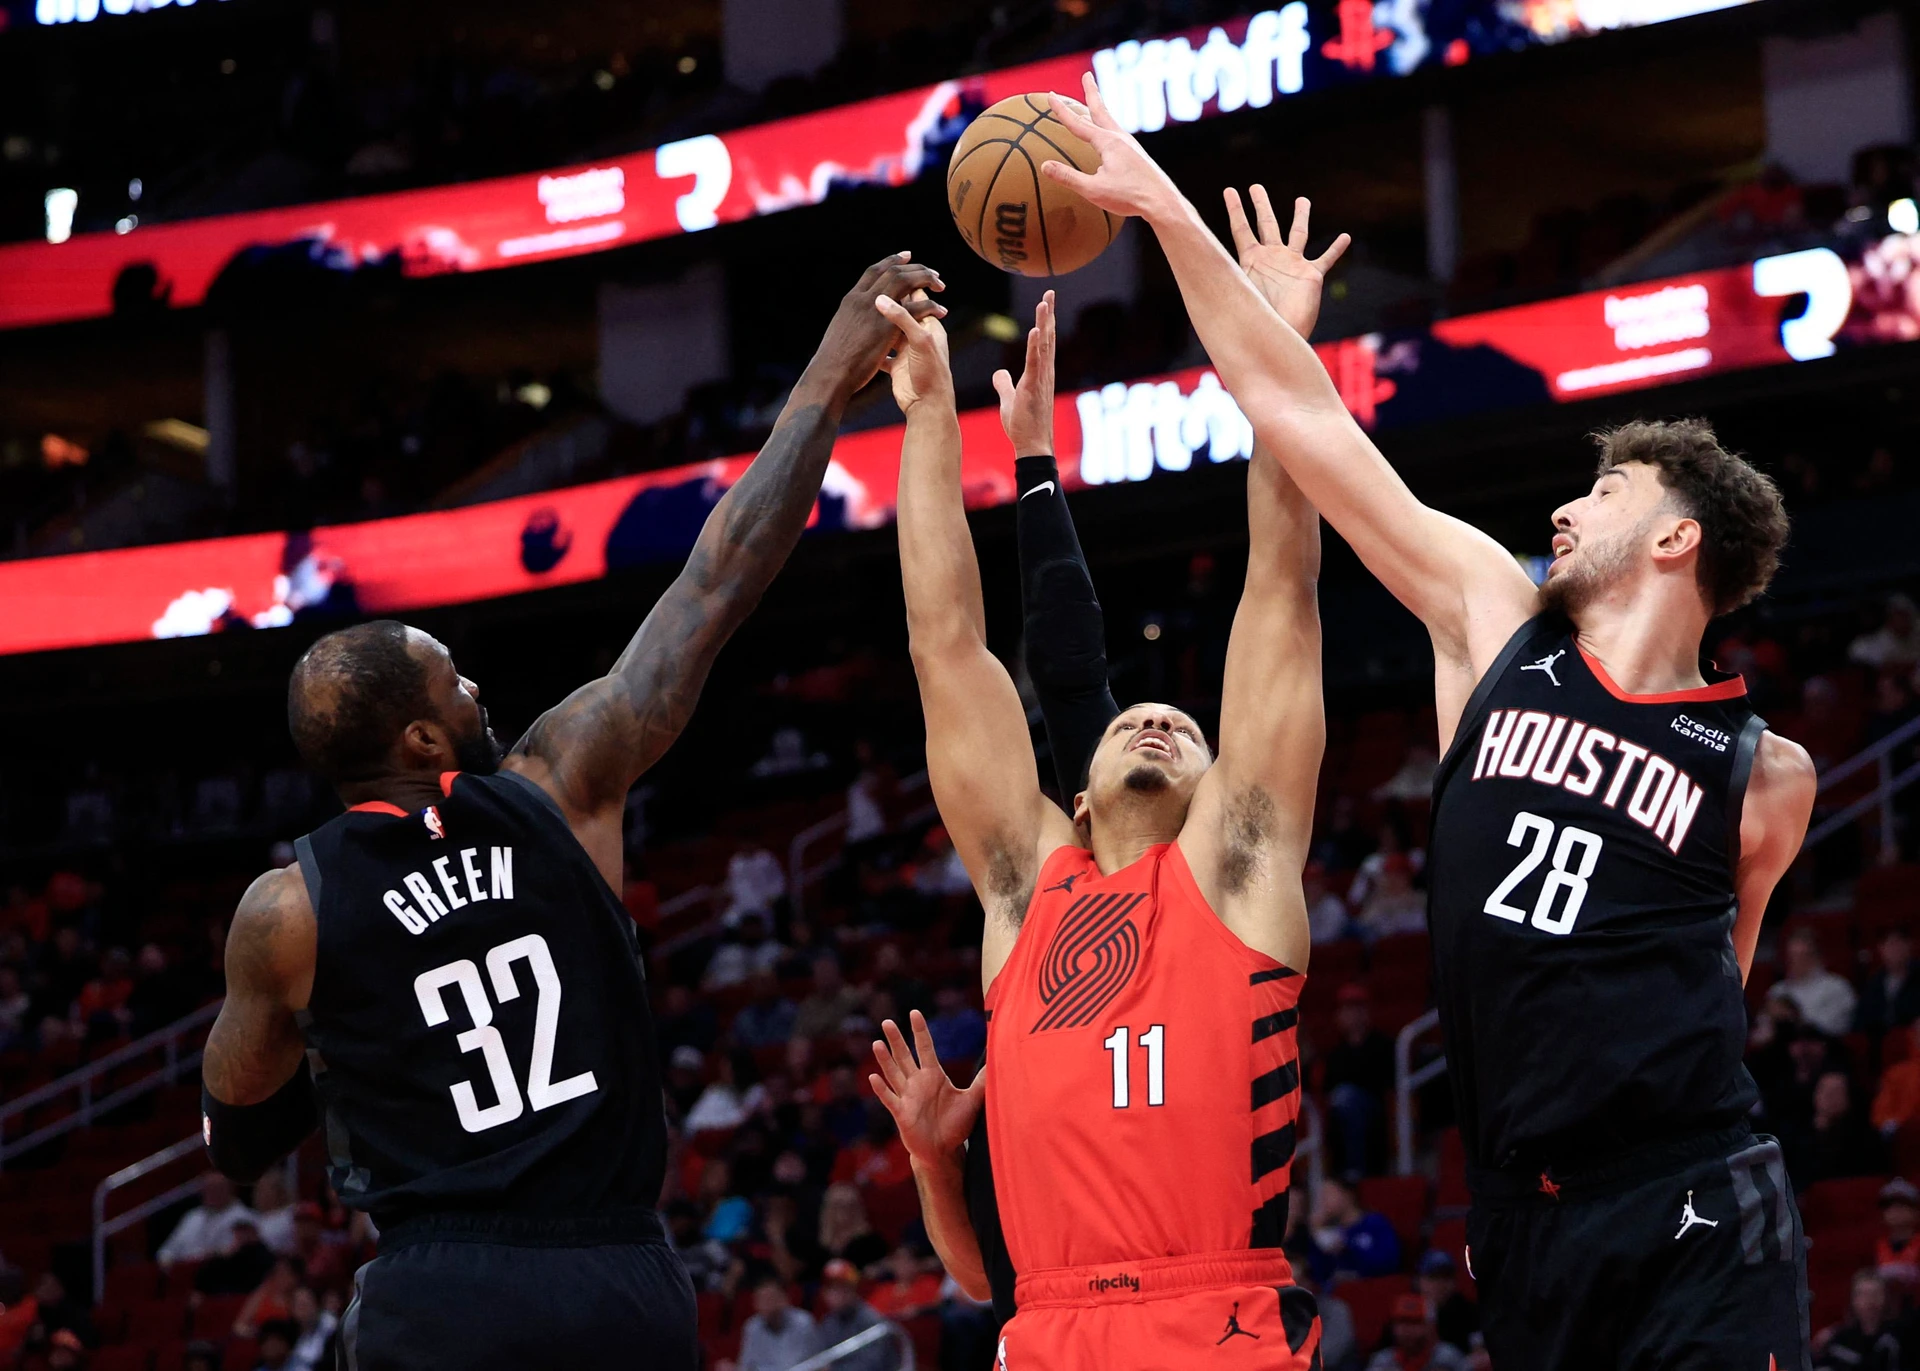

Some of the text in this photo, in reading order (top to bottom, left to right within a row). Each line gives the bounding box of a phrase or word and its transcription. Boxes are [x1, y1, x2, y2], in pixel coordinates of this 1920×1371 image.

[1076, 371, 1254, 485] lifto
[1670, 718, 1726, 752] karma
[1679, 714, 1731, 744] credit
[1472, 709, 1705, 857] HOUSTON
[383, 846, 514, 935] GREEN
[1483, 811, 1604, 936] 28
[414, 933, 599, 1133] 32
[1104, 1024, 1165, 1109] 11
[1088, 1272, 1140, 1293] ripcity
